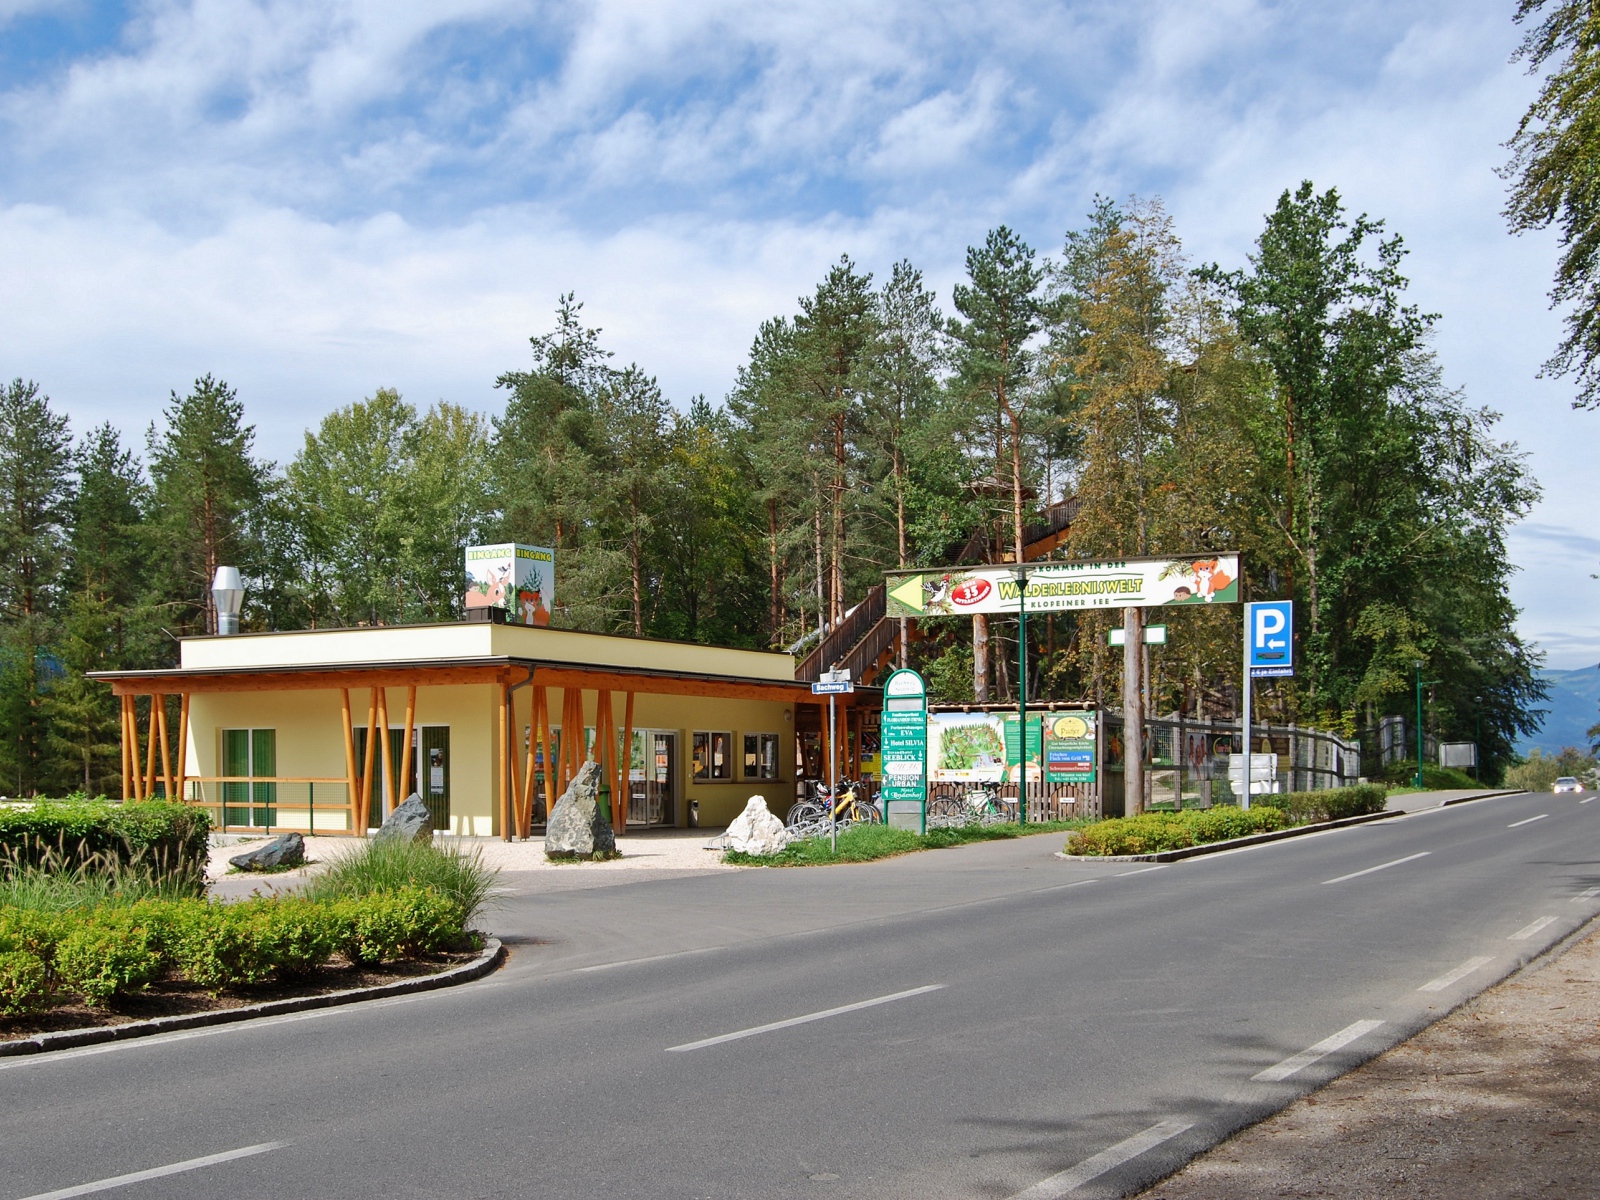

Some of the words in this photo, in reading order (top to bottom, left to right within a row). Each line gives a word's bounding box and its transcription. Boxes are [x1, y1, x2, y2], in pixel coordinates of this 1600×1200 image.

[468, 548, 512, 560] EINGANG
[516, 548, 552, 562] EINGANG
[963, 586, 978, 599] 35
[1256, 609, 1285, 648] P
